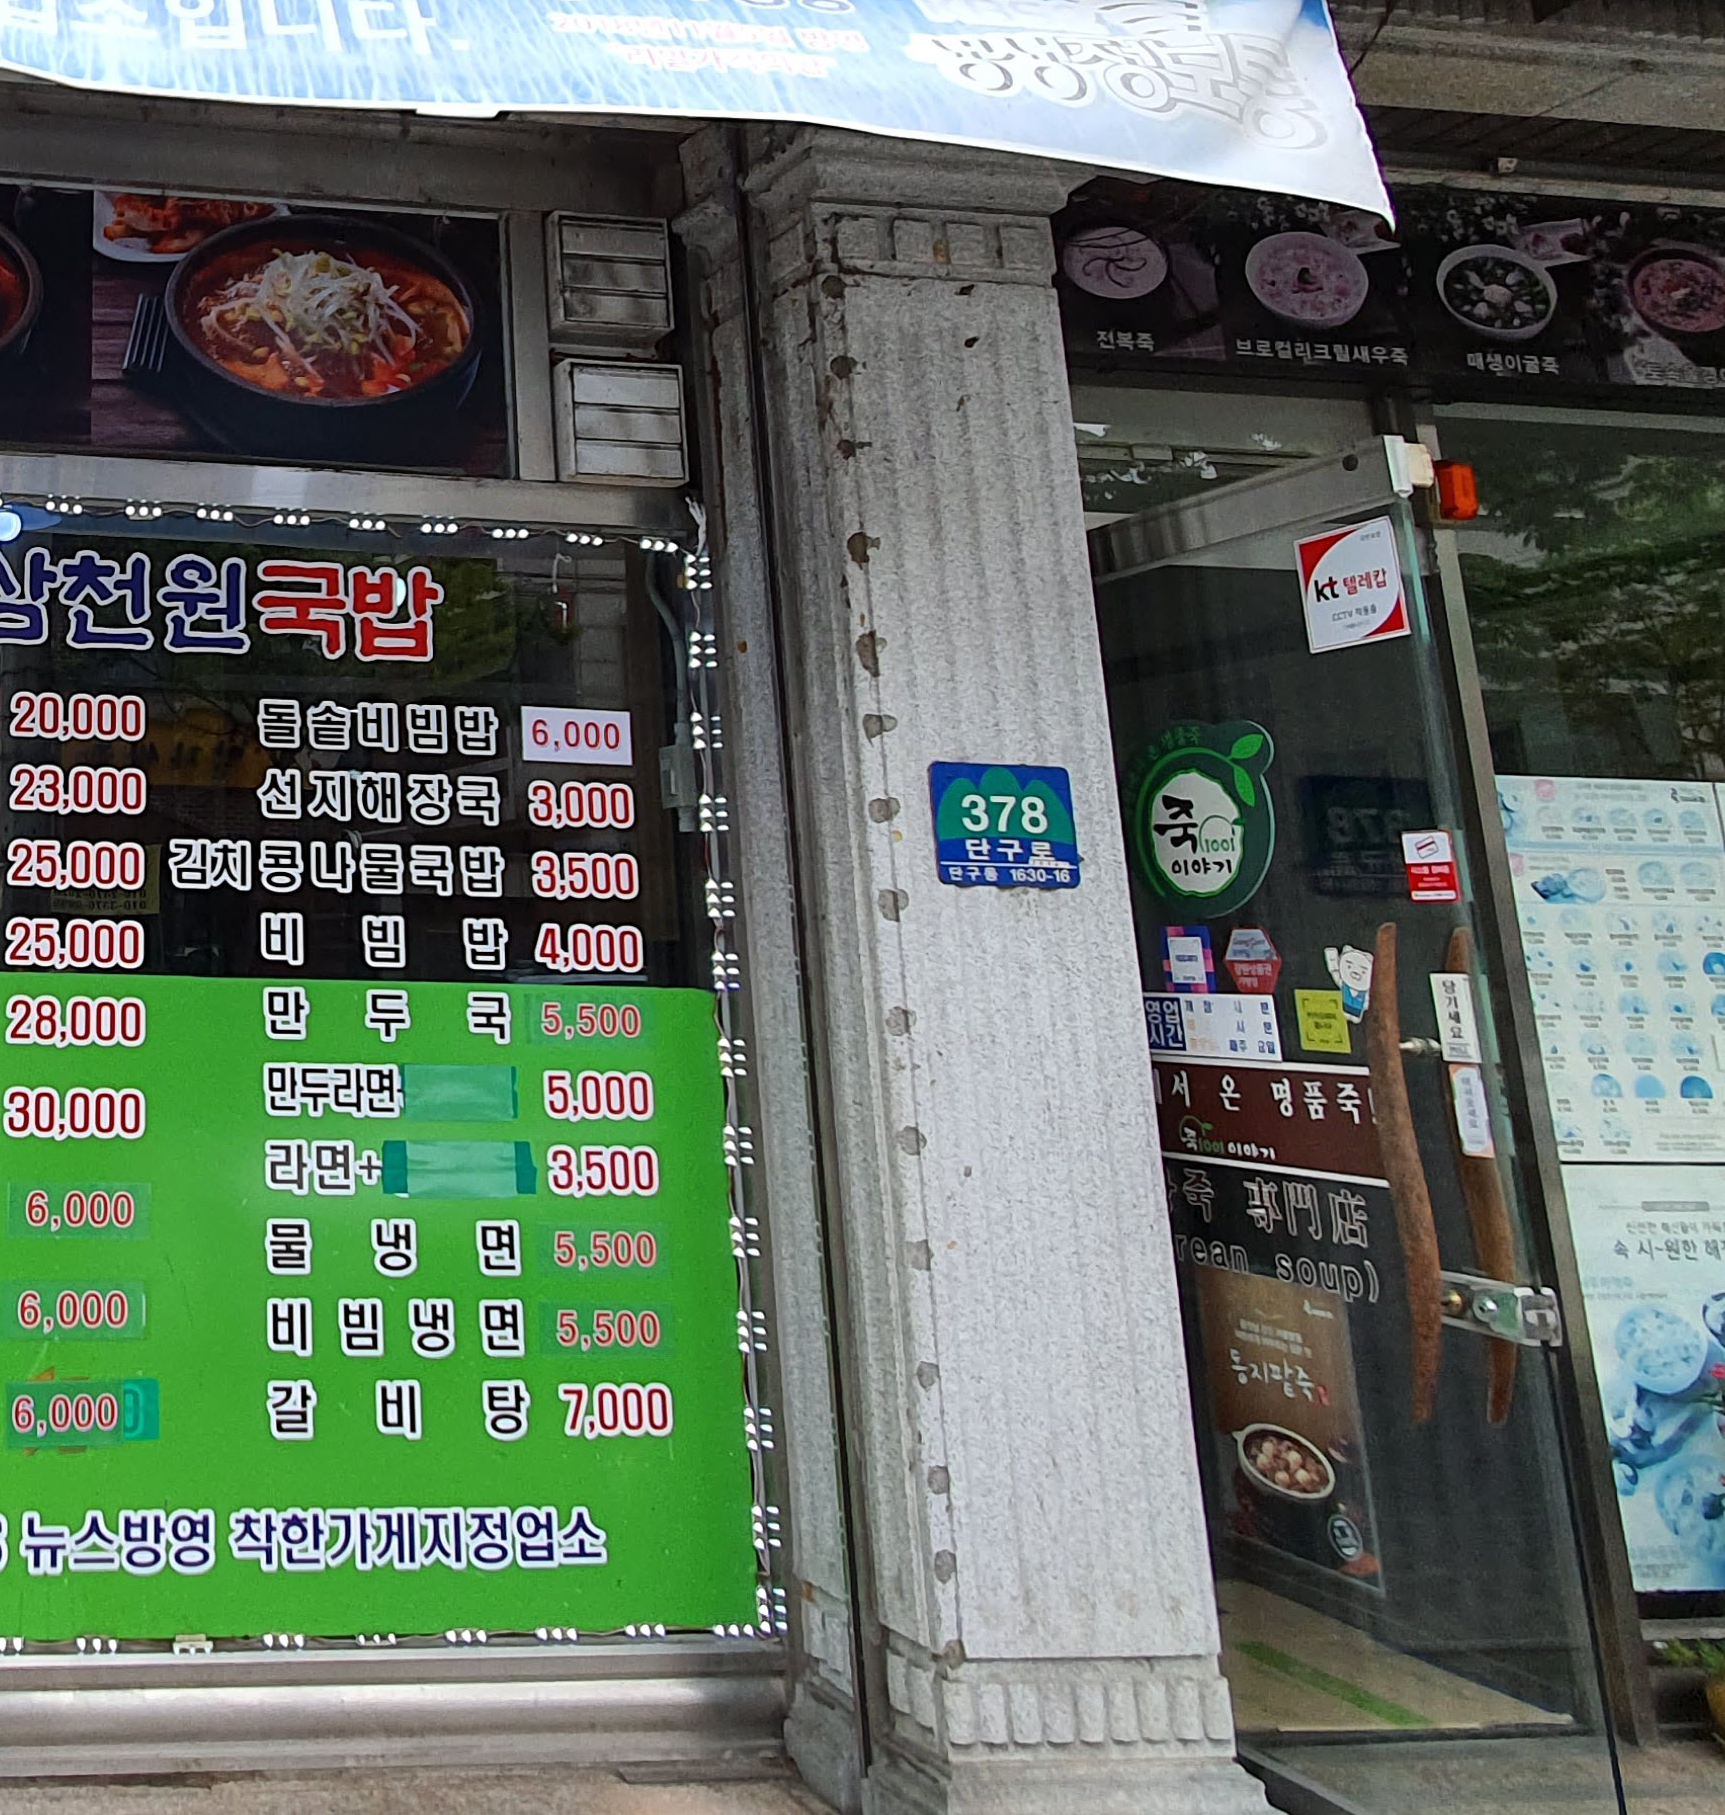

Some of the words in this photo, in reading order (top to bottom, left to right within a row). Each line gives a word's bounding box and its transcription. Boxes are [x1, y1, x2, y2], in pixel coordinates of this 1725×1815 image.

[1096, 330, 1155, 351] 전복죽
[1314, 576, 1340, 603] kt
[1342, 567, 1388, 596] 텔레캅
[9, 692, 147, 742] 20,000
[530, 718, 621, 752] 6,000
[9, 765, 147, 816] 23,000
[257, 768, 501, 827] 선지해장국
[528, 780, 635, 830] 3,000
[961, 794, 1048, 834] 378
[1153, 794, 1199, 854] 죽
[7, 841, 146, 892] 25,000
[965, 837, 1056, 863] 단구로
[1171, 857, 1233, 876] 이야기
[531, 852, 639, 901] 3,500
[948, 866, 999, 882] 단구동
[1009, 868, 1071, 883] 1630-16
[5, 919, 145, 970] 25,000
[534, 923, 645, 974] 4,000
[5, 995, 146, 1048] 28,000
[540, 1002, 642, 1041] 5,500
[1145, 1000, 1180, 1024] 영업
[1150, 1024, 1184, 1048] 시간
[3, 1086, 146, 1142] 30,000
[543, 1070, 654, 1121] 5,000
[1219, 1073, 1241, 1111] 온
[547, 1145, 660, 1198] 3,500
[1227, 1141, 1276, 1160] 이야기
[25, 1190, 135, 1232] 6,000
[1243, 1176, 1369, 1249] 專門店
[552, 1231, 657, 1272] 5,500
[1613, 1239, 1629, 1260] 속
[1275, 1252, 1380, 1303] soup)
[17, 1290, 128, 1333] 6,000
[556, 1310, 661, 1352] 5,500
[1230, 1348, 1315, 1402] 동지팥죽
[12, 1393, 119, 1437] 6,000
[558, 1383, 674, 1439] 7,000
[21, 1508, 218, 1574] 뉴스방영
[228, 1506, 610, 1572] 착한가게지정업소
